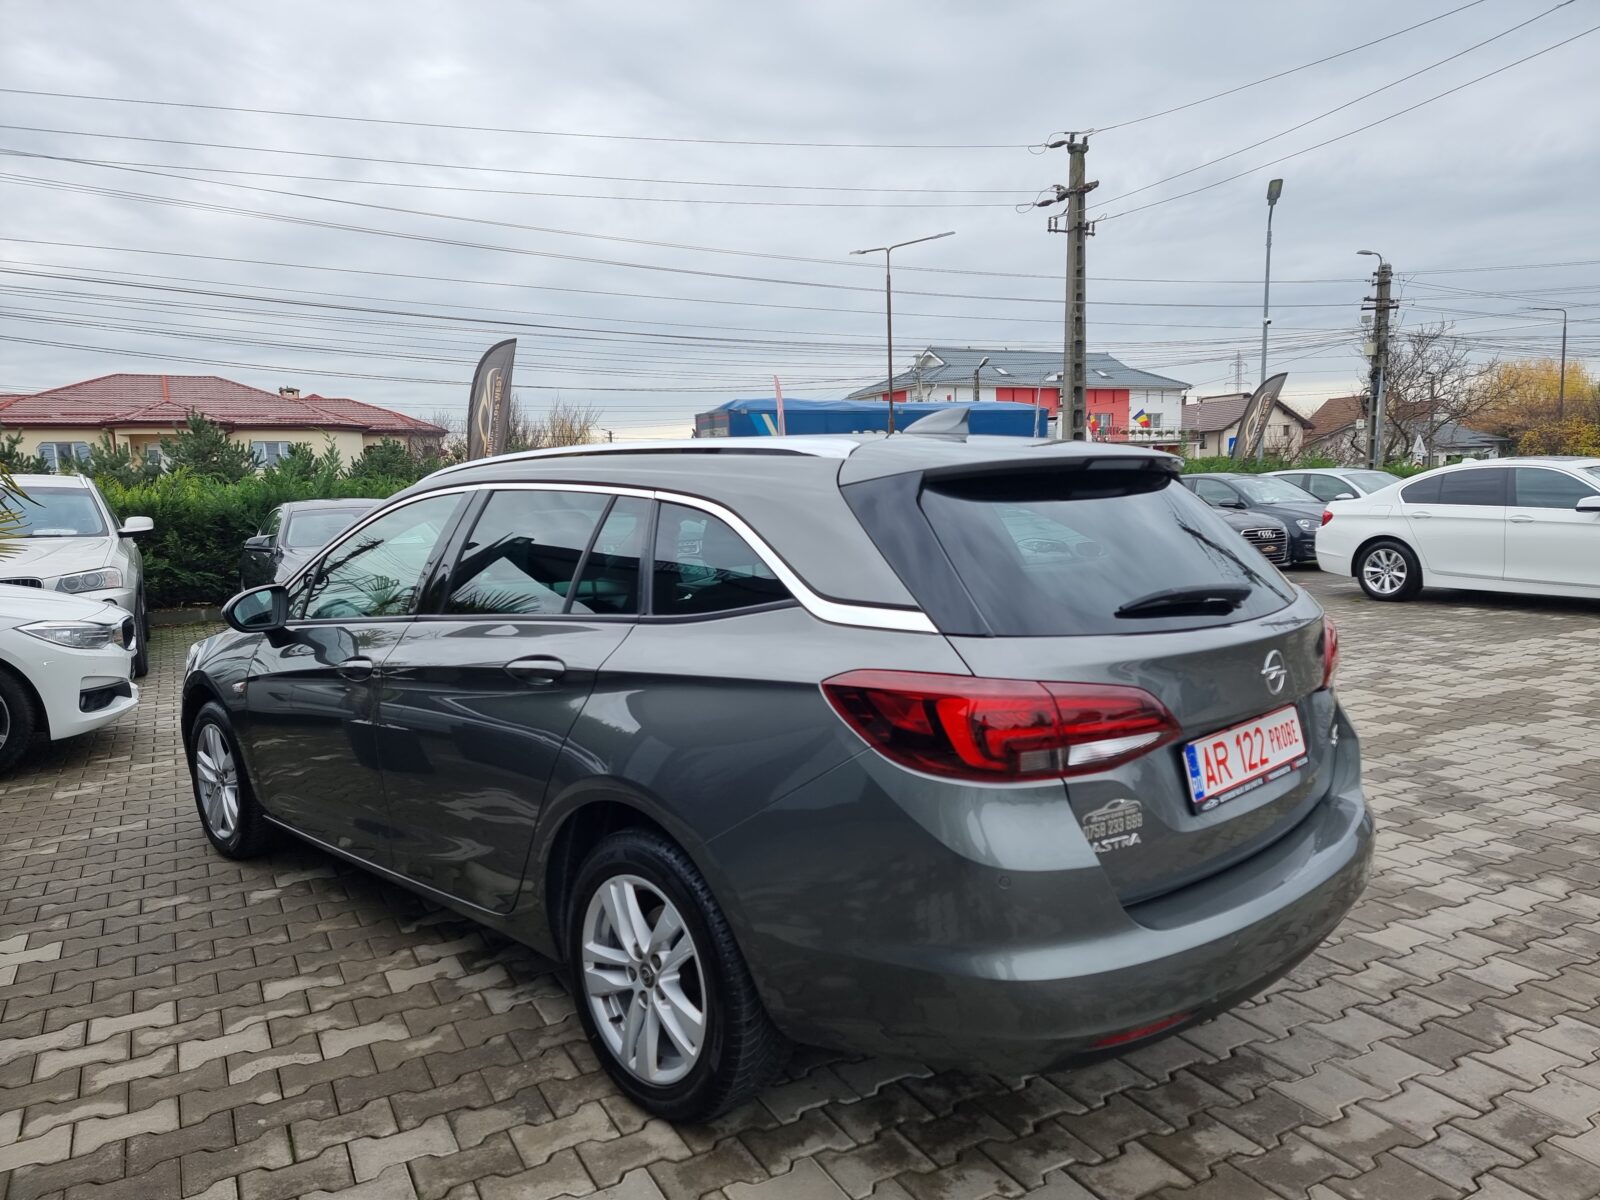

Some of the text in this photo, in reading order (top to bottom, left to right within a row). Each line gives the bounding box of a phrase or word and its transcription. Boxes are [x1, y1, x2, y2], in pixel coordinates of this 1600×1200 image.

[1204, 741, 1233, 789] AR
[1236, 727, 1269, 773] 122
[1268, 719, 1299, 754] PROBE
